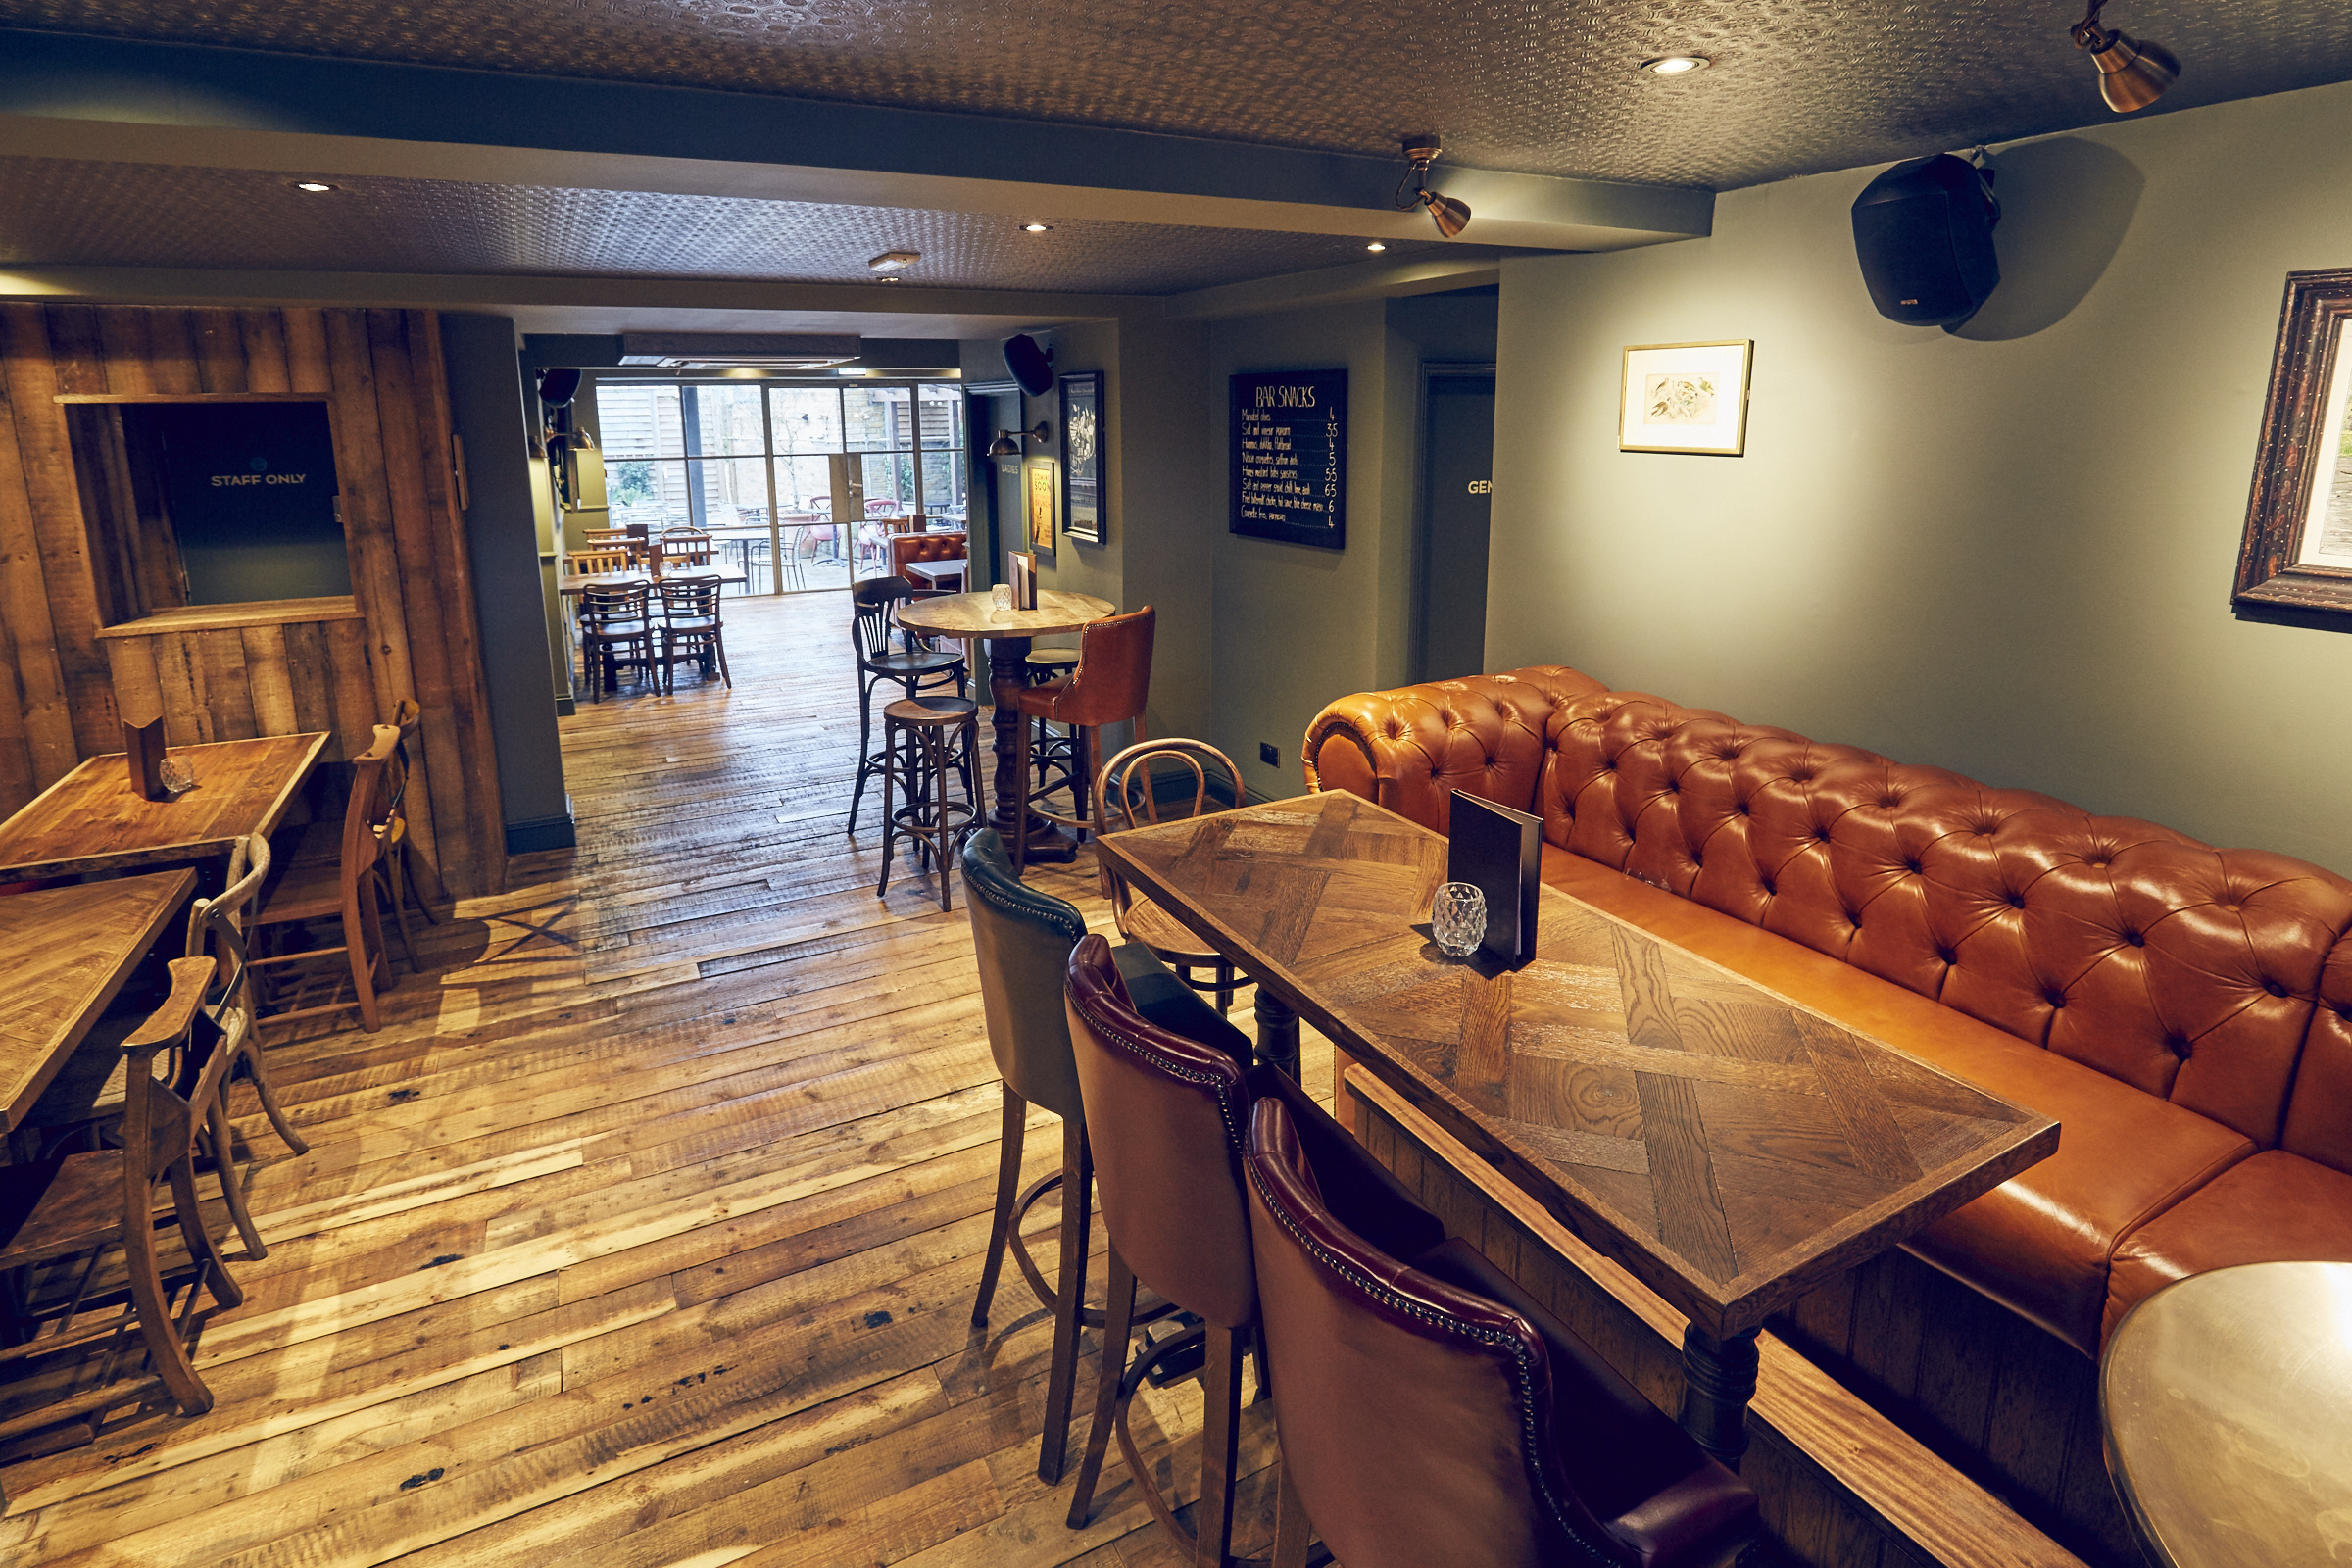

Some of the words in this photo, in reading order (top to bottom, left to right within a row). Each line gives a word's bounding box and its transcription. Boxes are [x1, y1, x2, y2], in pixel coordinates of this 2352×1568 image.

[1256, 386, 1276, 408] BAR
[1278, 385, 1316, 408] SNACKS
[1329, 406, 1336, 421] 4
[1329, 437, 1334, 451] 4
[1329, 452, 1336, 466] 5
[1002, 463, 1019, 474] LADIES
[211, 474, 261, 487] STAFF
[265, 474, 306, 485] ONLY
[1329, 500, 1335, 513] 6
[1329, 515, 1335, 529] 4
